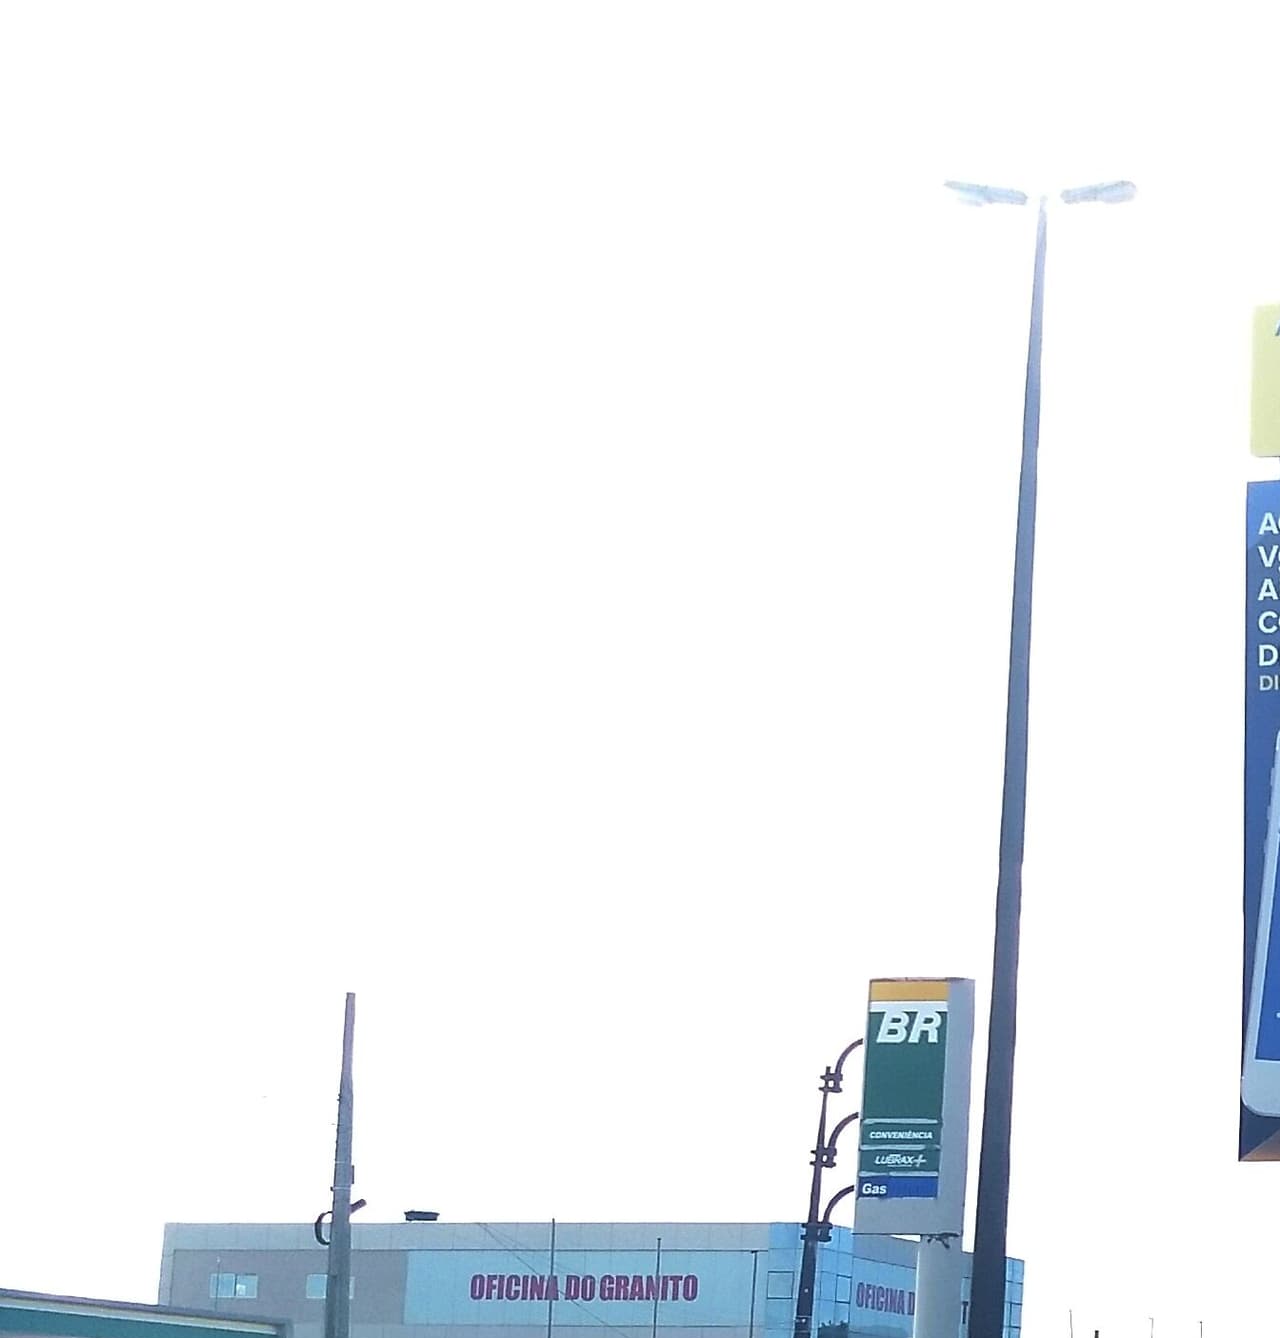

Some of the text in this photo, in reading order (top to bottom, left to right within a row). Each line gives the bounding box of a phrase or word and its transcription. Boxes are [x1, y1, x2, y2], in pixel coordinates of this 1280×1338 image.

[876, 1008, 942, 1044] BR
[470, 1274, 699, 1302] OFICINA DO GRANITO
[855, 1282, 905, 1315] OFICINA
